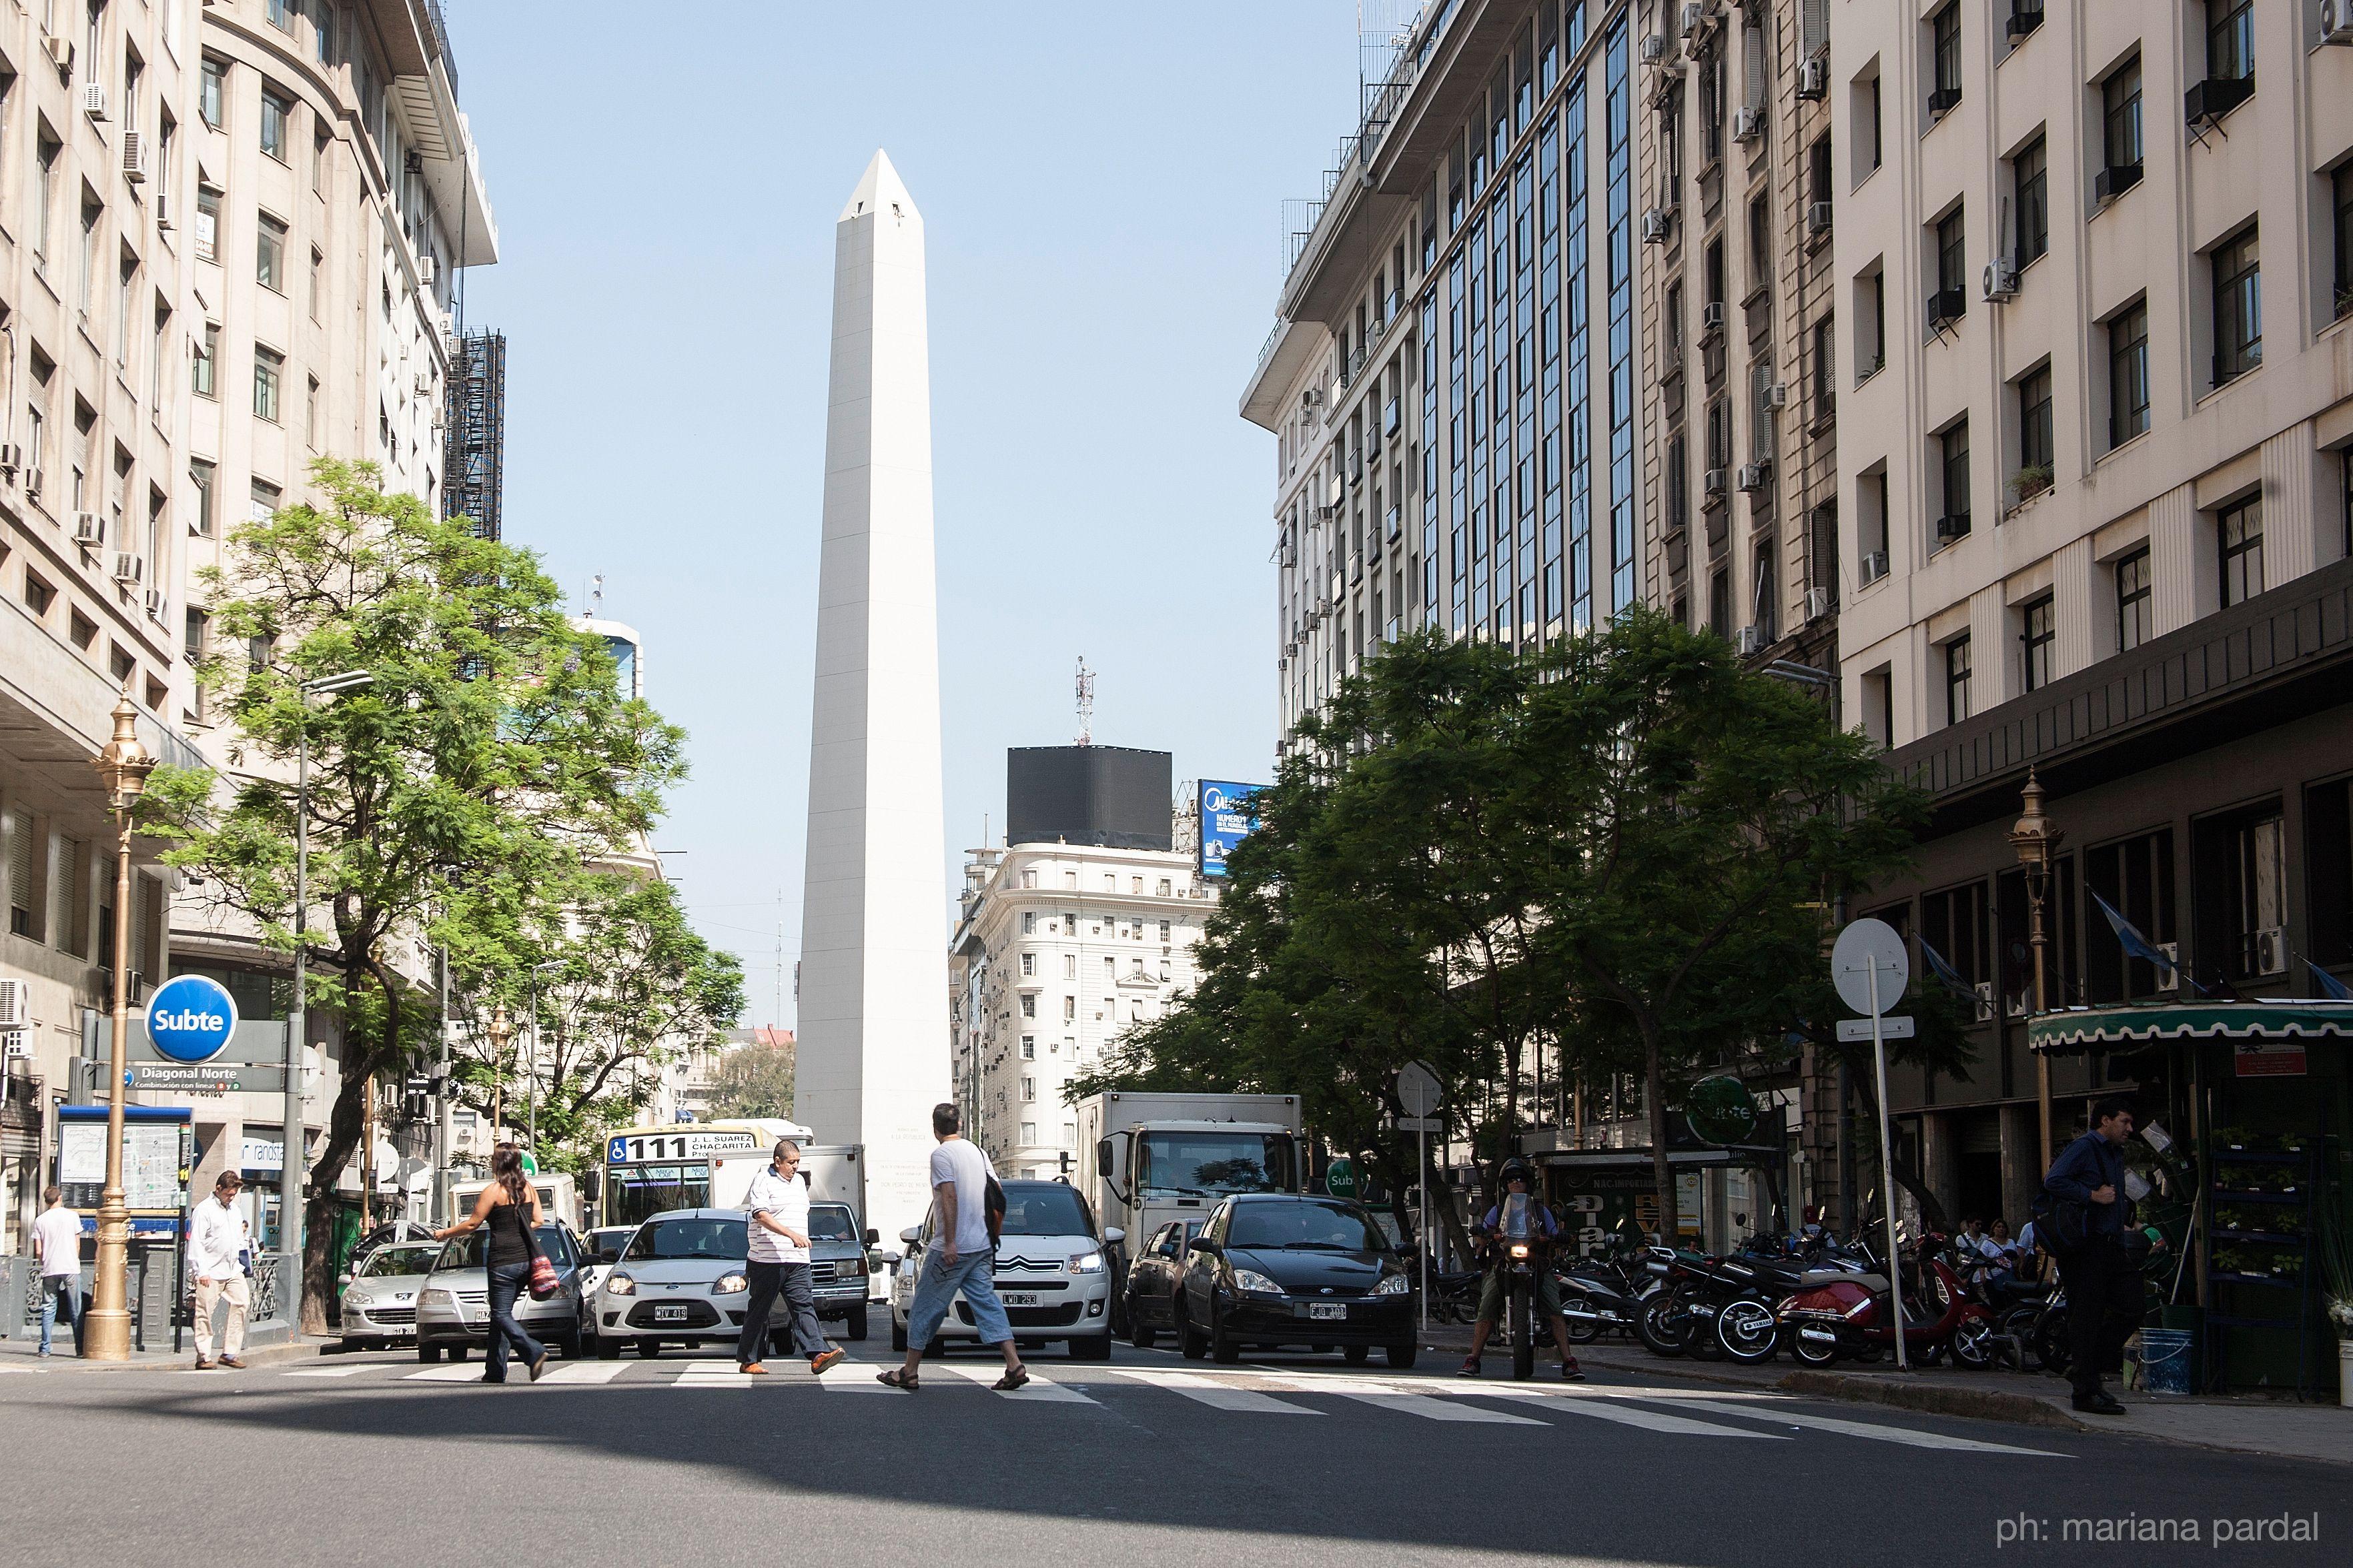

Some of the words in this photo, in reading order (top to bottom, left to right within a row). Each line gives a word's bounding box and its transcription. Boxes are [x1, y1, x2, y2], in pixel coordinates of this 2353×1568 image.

[155, 1008, 224, 1031] Subte
[141, 1068, 197, 1080] Diagonal
[201, 1068, 238, 1079] Norte
[254, 1143, 284, 1161] randsta
[628, 1138, 686, 1159] 111
[1729, 1150, 1746, 1158] ulio
[1003, 1295, 1018, 1304] LWD
[1021, 1295, 1036, 1304] 293
[476, 1311, 490, 1320] HAZ
[656, 1309, 669, 1318] MIV
[672, 1309, 686, 1317] 419
[1753, 1319, 1773, 1327] YAMAHA
